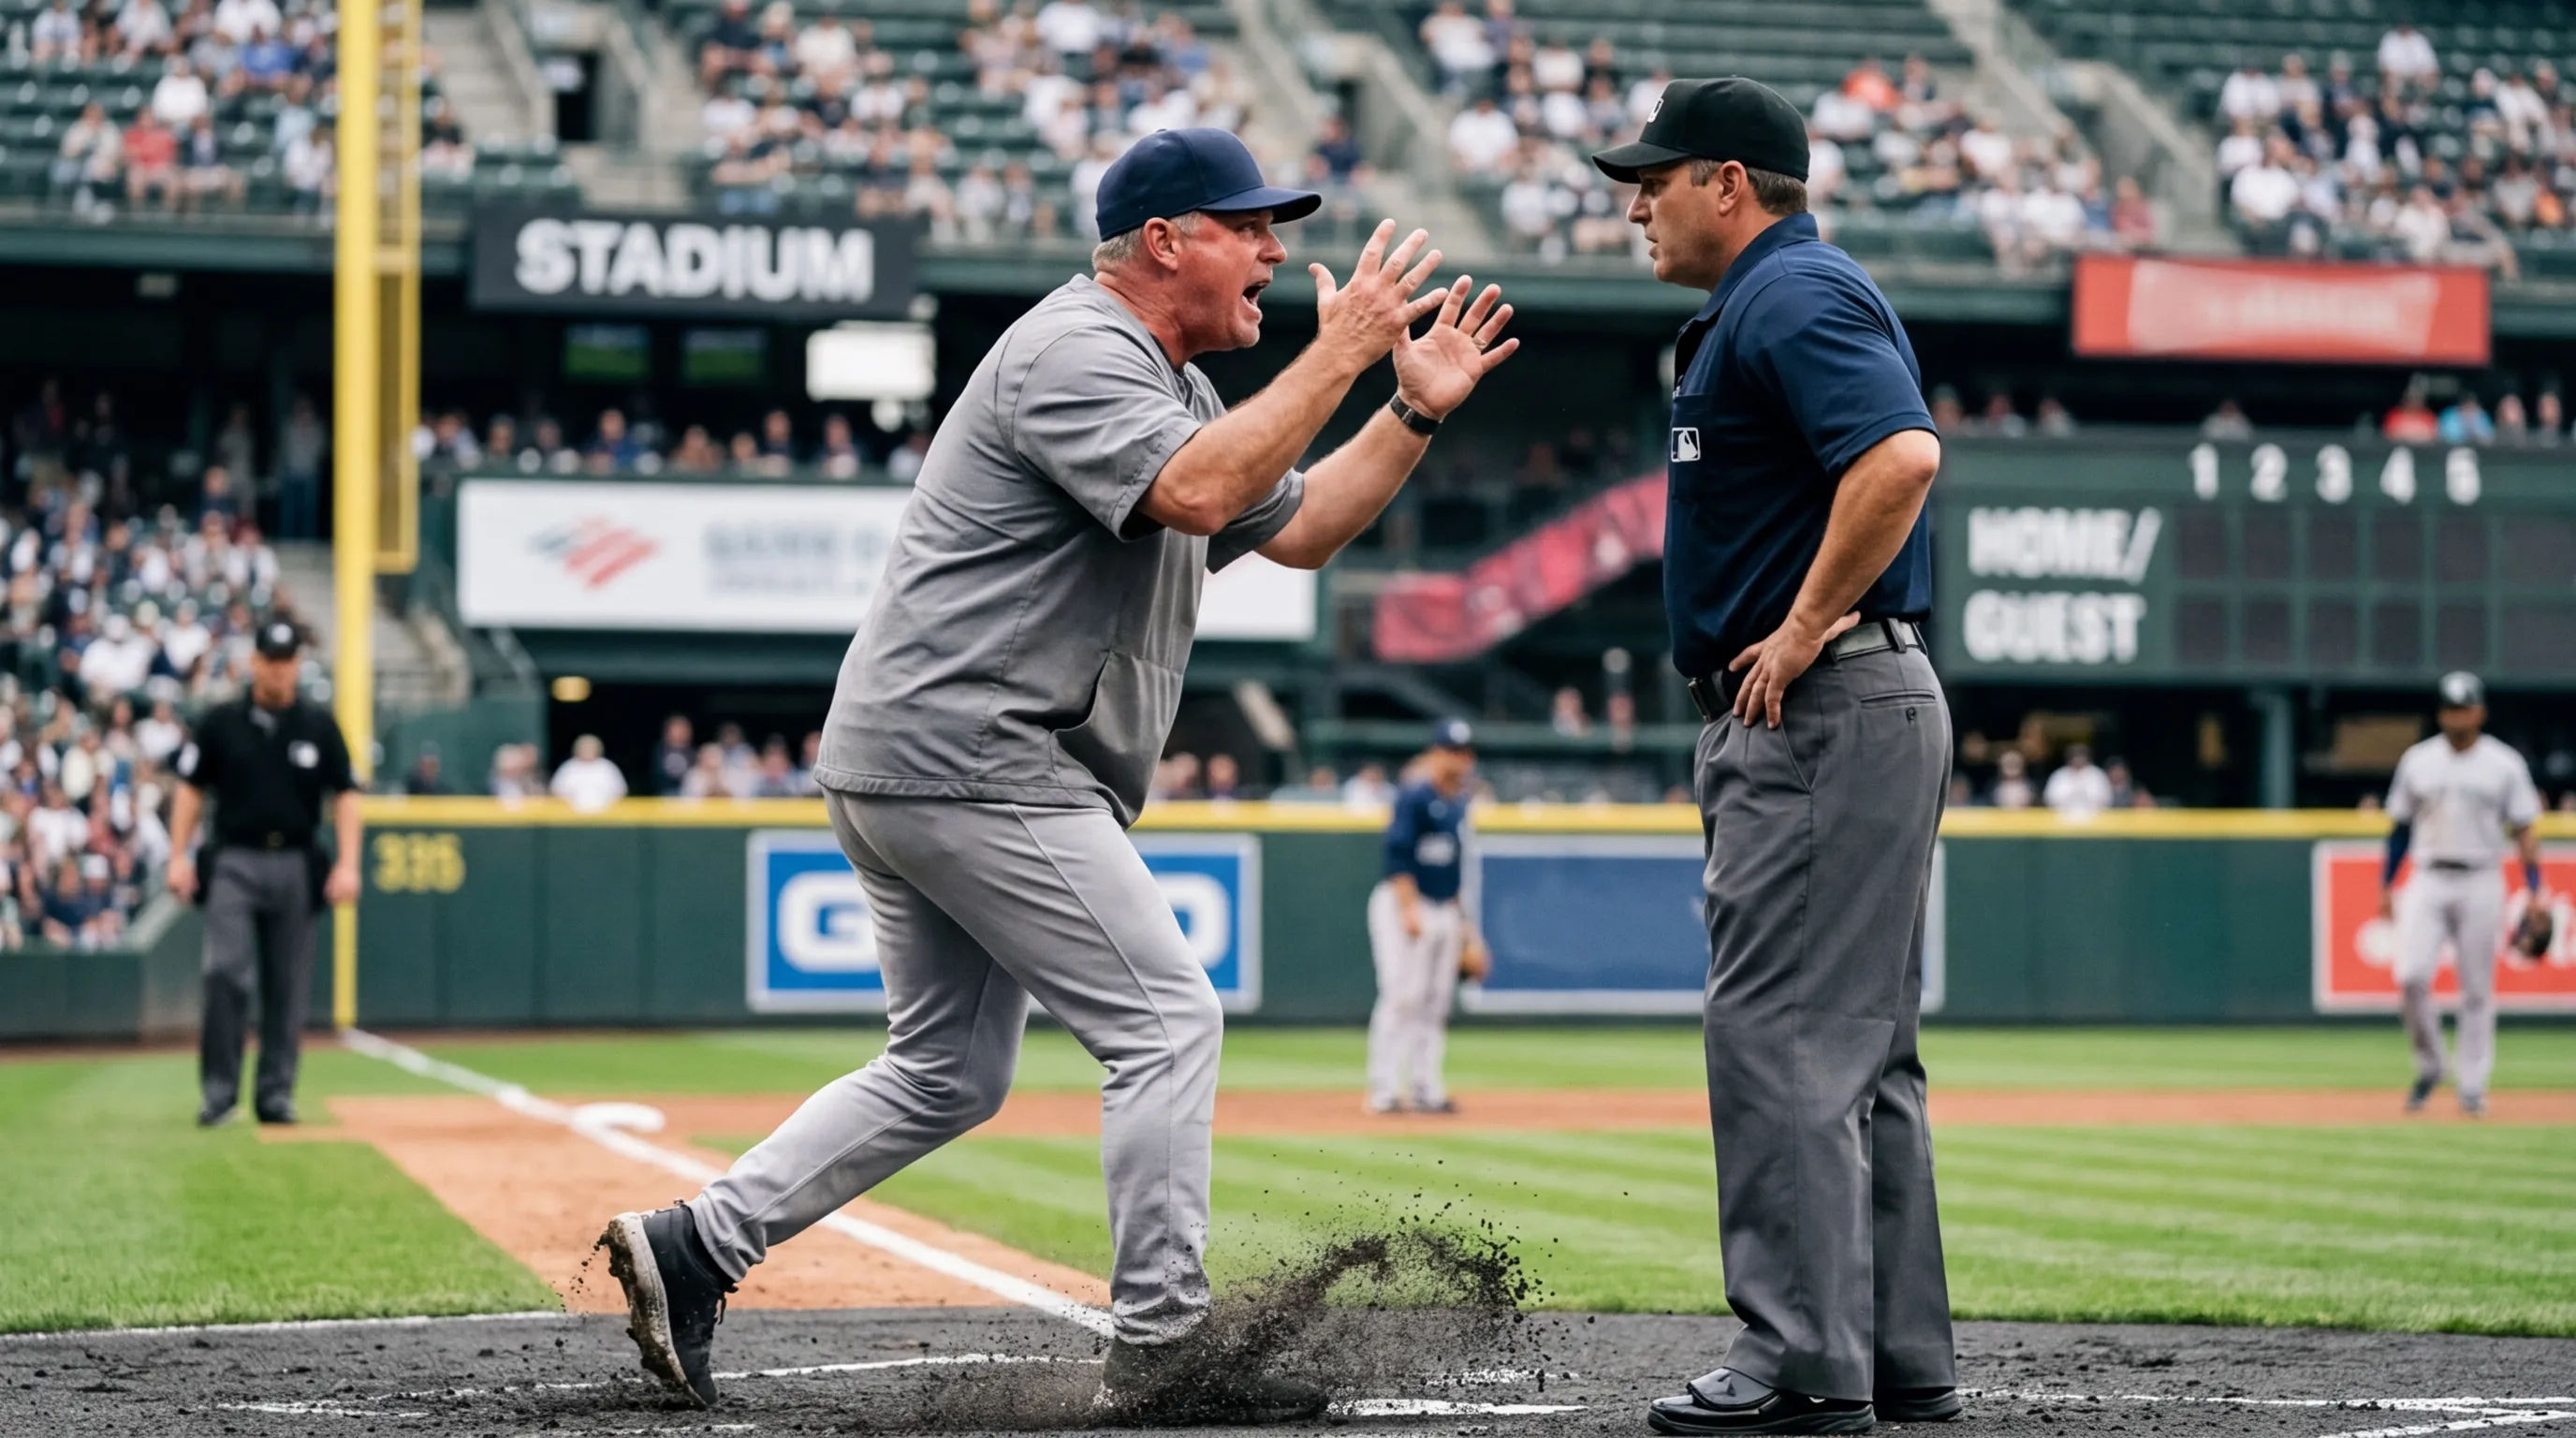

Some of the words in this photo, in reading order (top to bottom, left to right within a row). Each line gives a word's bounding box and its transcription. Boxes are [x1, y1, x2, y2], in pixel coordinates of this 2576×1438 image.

[516, 219, 873, 302] STADIUM
[2188, 443, 2219, 500] 1
[2250, 444, 2288, 503] 2
[2316, 445, 2352, 505] 3
[2379, 446, 2416, 506] 4
[1963, 589, 2147, 664] GUEST
